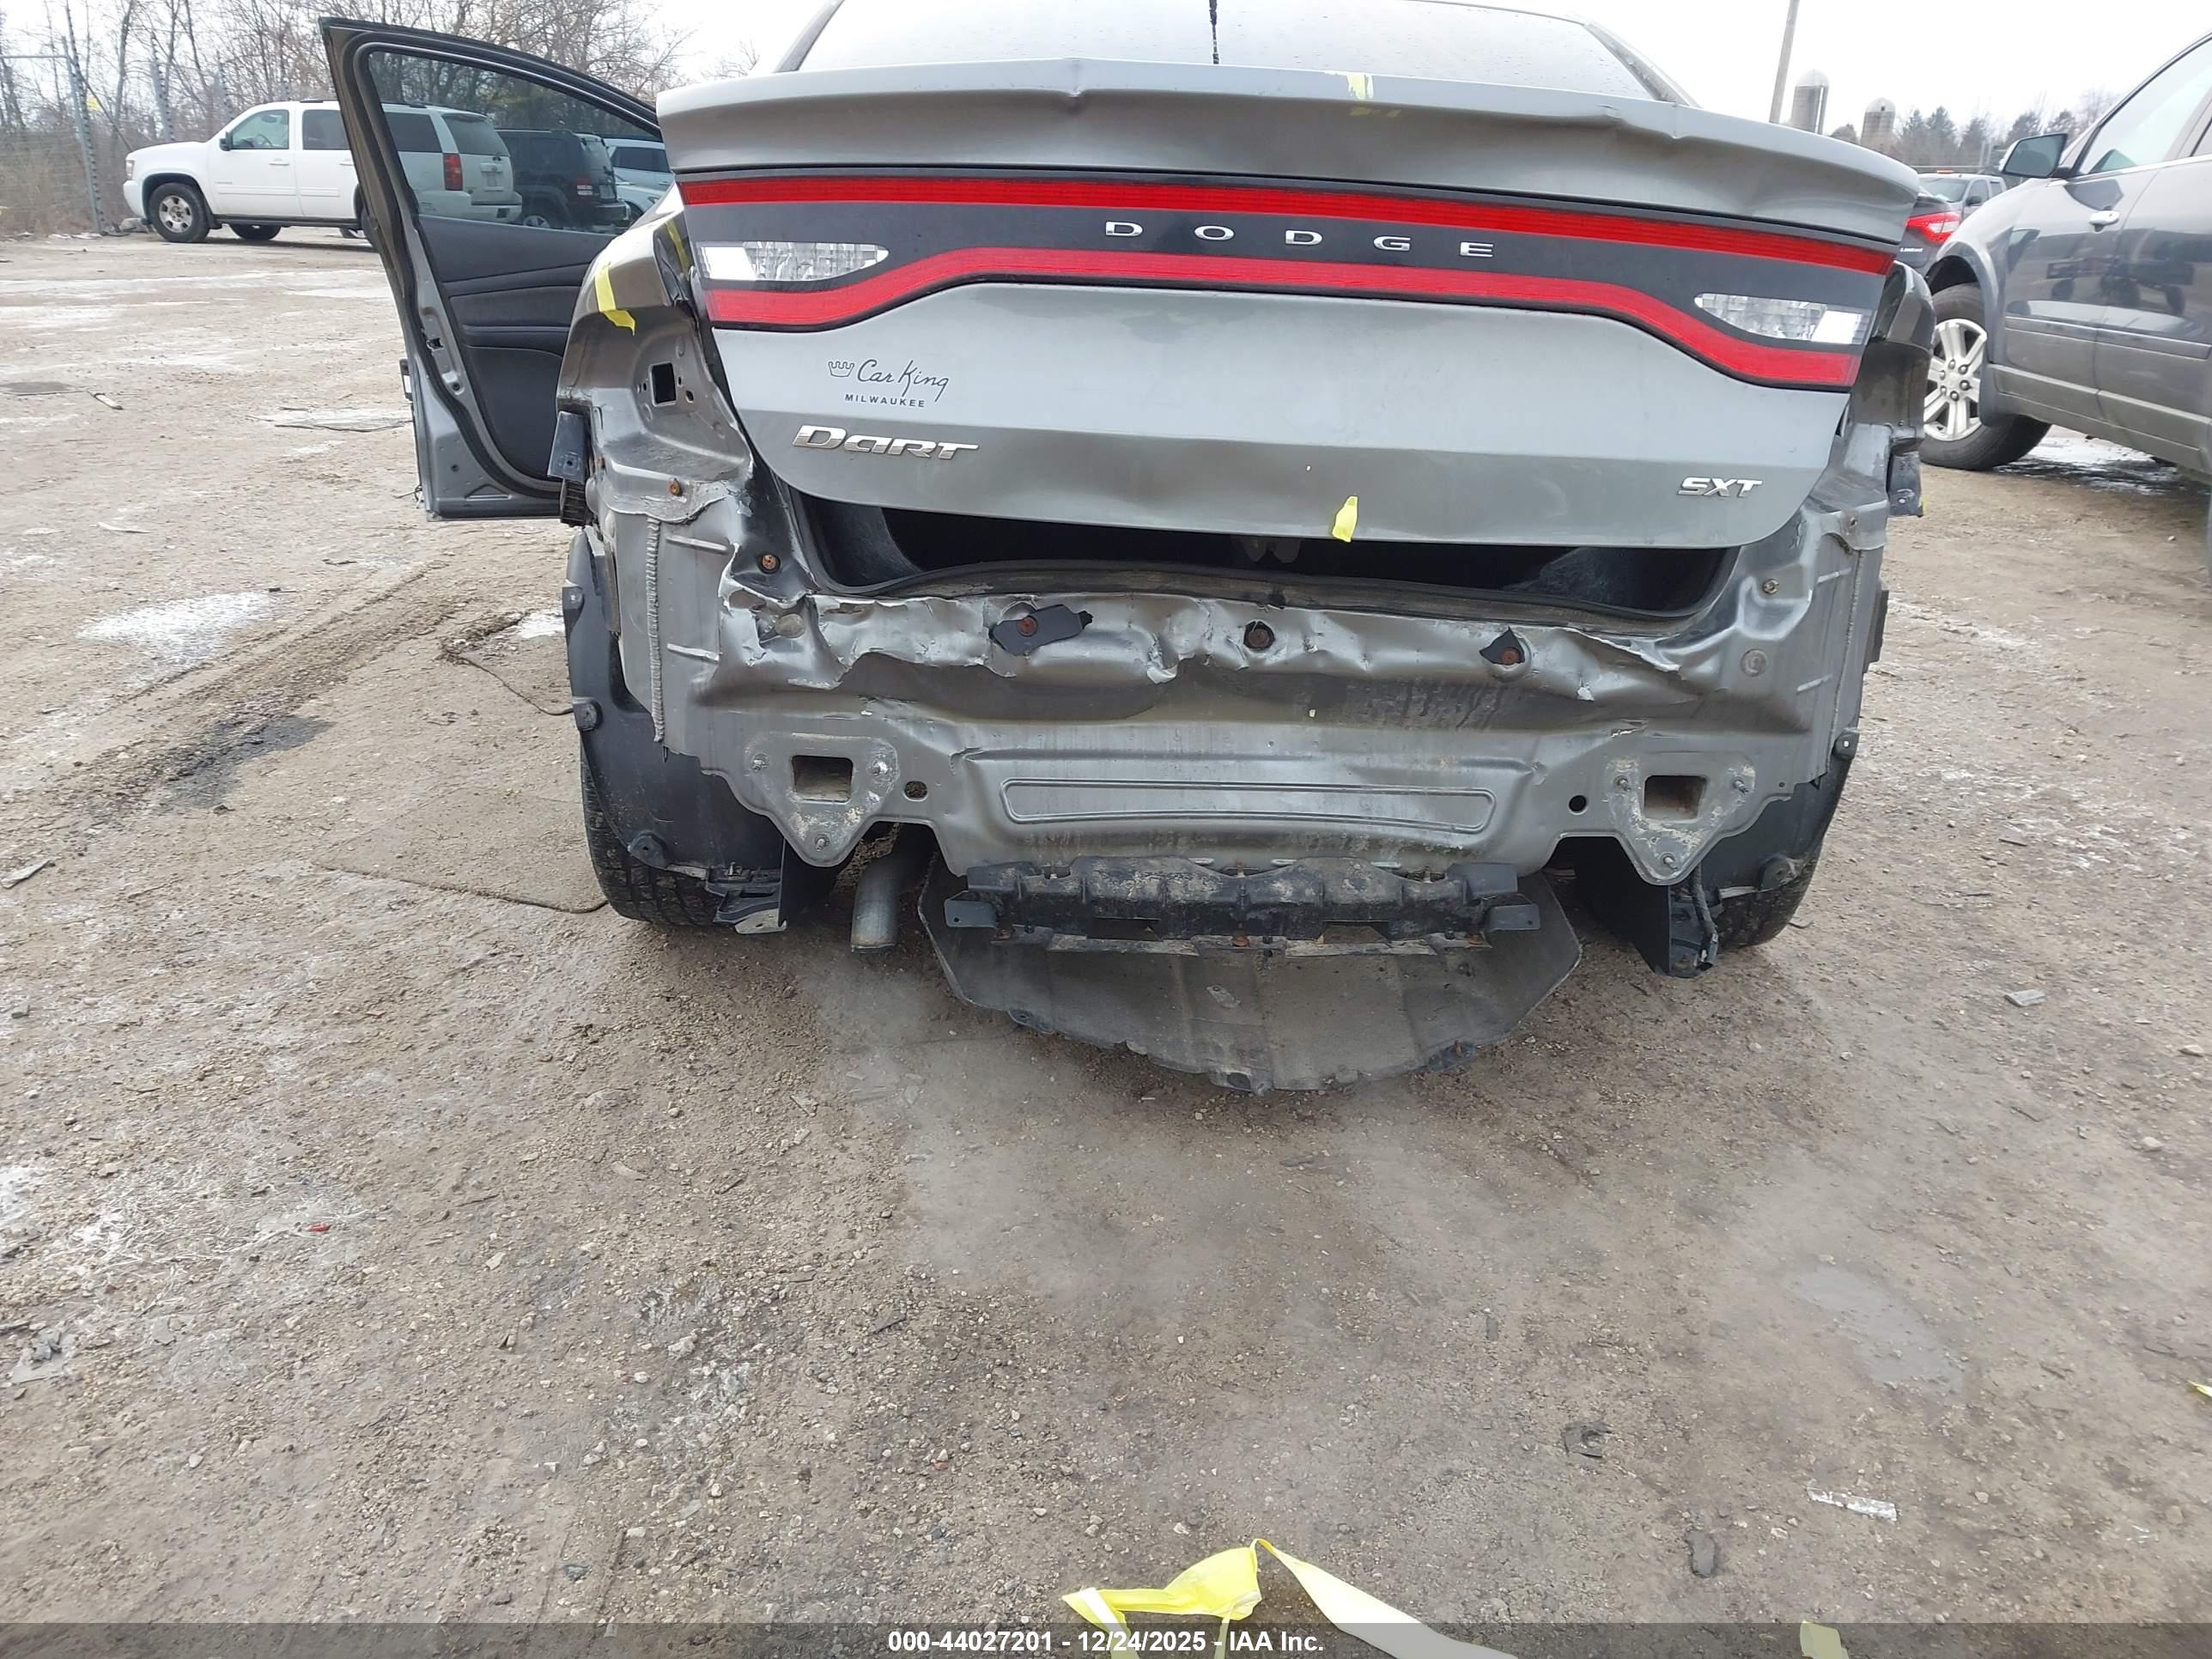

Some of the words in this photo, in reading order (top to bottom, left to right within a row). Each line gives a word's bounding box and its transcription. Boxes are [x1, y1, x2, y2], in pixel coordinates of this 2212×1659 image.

[1104, 220, 1494, 258] DODGE
[857, 358, 895, 383] Car
[897, 359, 950, 403] King
[844, 393, 927, 408] MILWAUKEE
[1676, 476, 1763, 498] SXT
